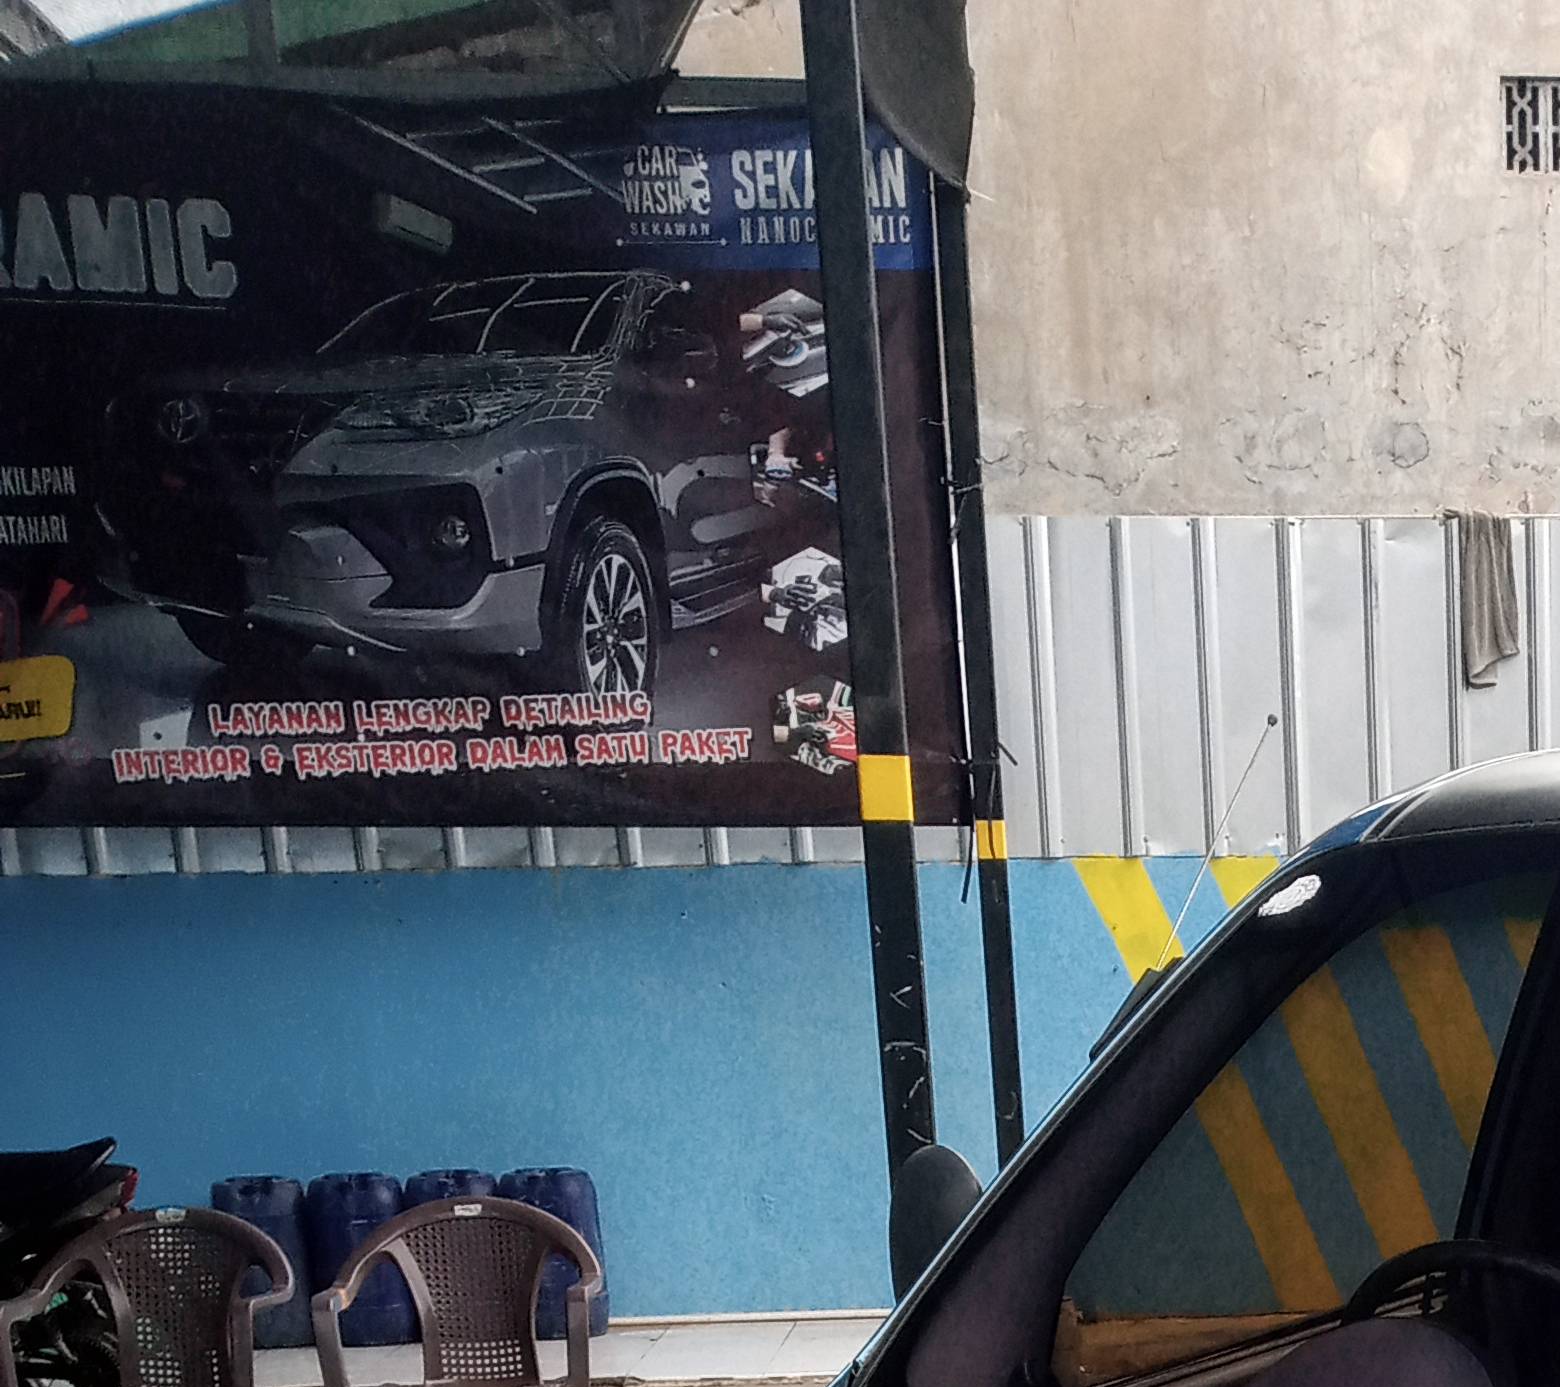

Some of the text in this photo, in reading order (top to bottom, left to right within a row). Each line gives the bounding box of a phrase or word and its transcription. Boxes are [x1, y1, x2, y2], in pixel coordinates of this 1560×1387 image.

[637, 145, 678, 176] CAR
[731, 148, 907, 210] SEKAN
[622, 180, 684, 214] WASH
[630, 221, 710, 236] SEKAWAN
[0, 465, 76, 496] KILAPAN
[207, 692, 651, 736] LAYANAN LENGKAP DETAILING
[112, 727, 752, 783] INTERIOR & EKSTERIOR DALAM SATU PAKET
